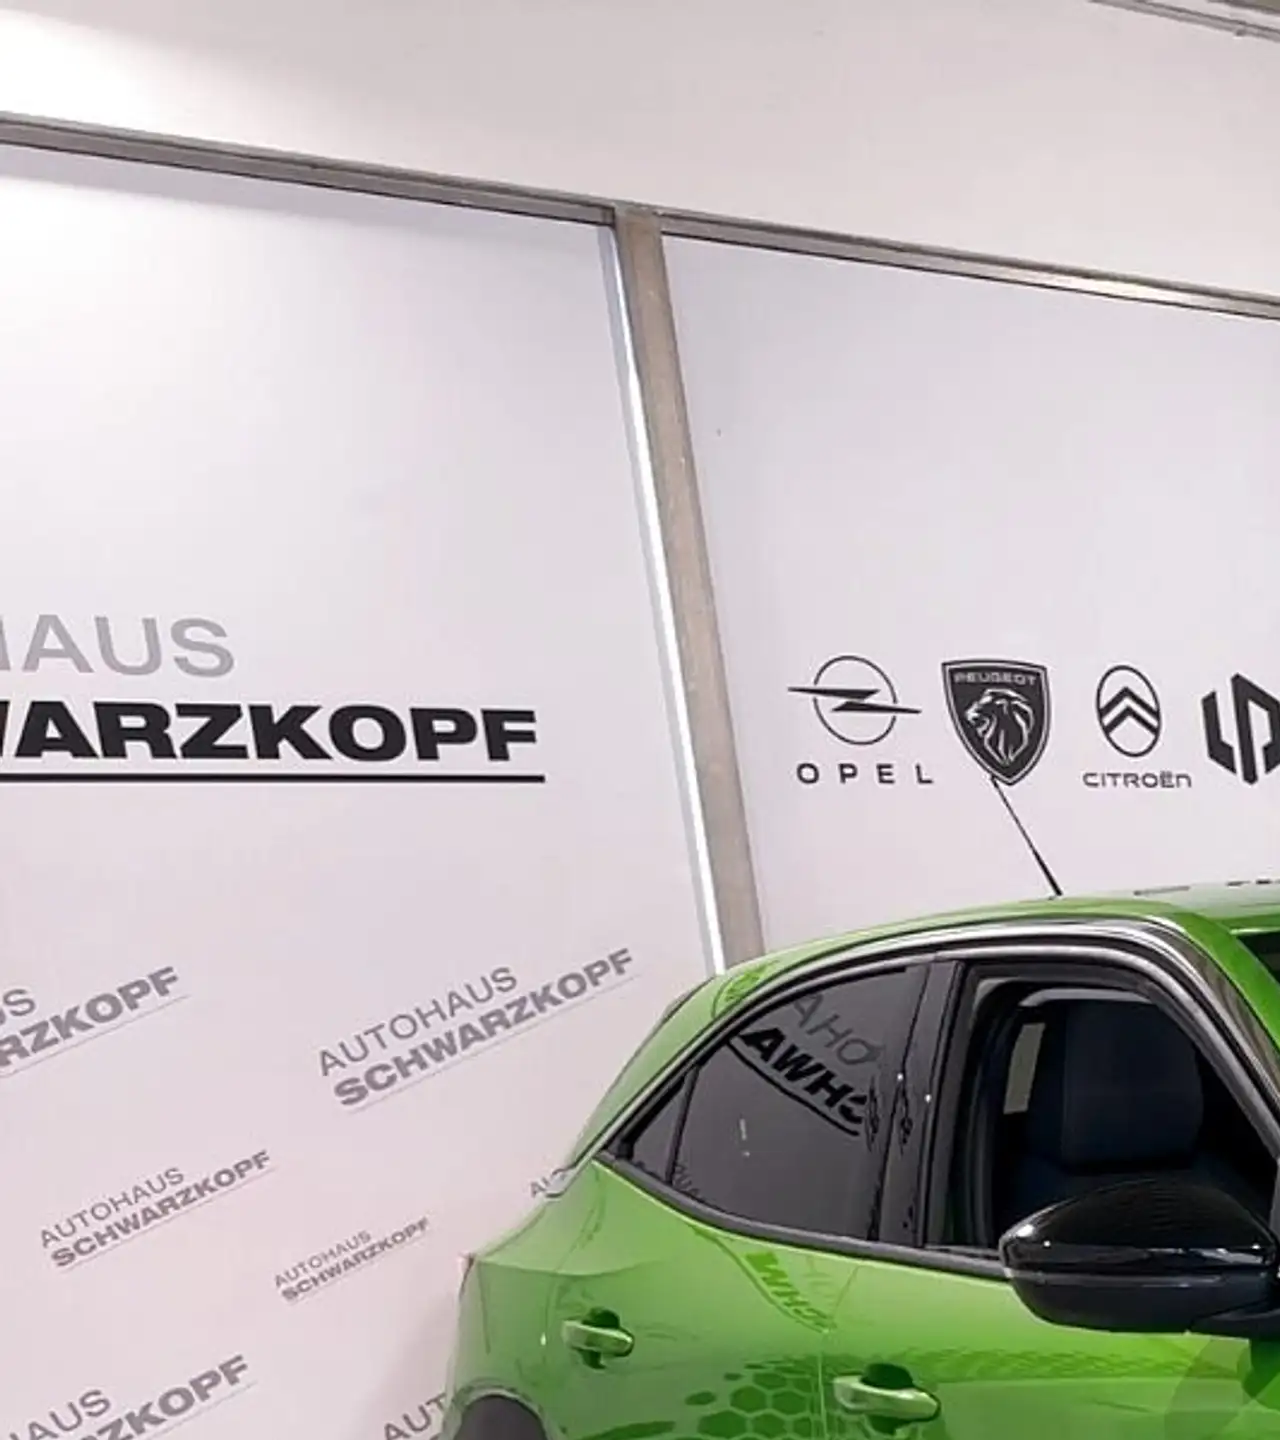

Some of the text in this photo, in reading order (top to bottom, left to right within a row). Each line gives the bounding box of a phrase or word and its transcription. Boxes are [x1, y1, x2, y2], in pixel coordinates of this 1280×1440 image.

[0, 614, 235, 678] AUS
[953, 671, 1038, 687] PEUGEOT
[0, 700, 537, 762] ARZKOPF
[796, 762, 934, 785] OPEL
[318, 966, 518, 1077] AUTOHAUS
[333, 947, 633, 1107] SCHWARZKOPF
[39, 1166, 185, 1249] AUTOHAUS
[50, 1149, 271, 1268] SCHWARZKOPF
[274, 1229, 372, 1289] AUTOHAUS
[281, 1215, 429, 1302] SCHWARZKOPF
